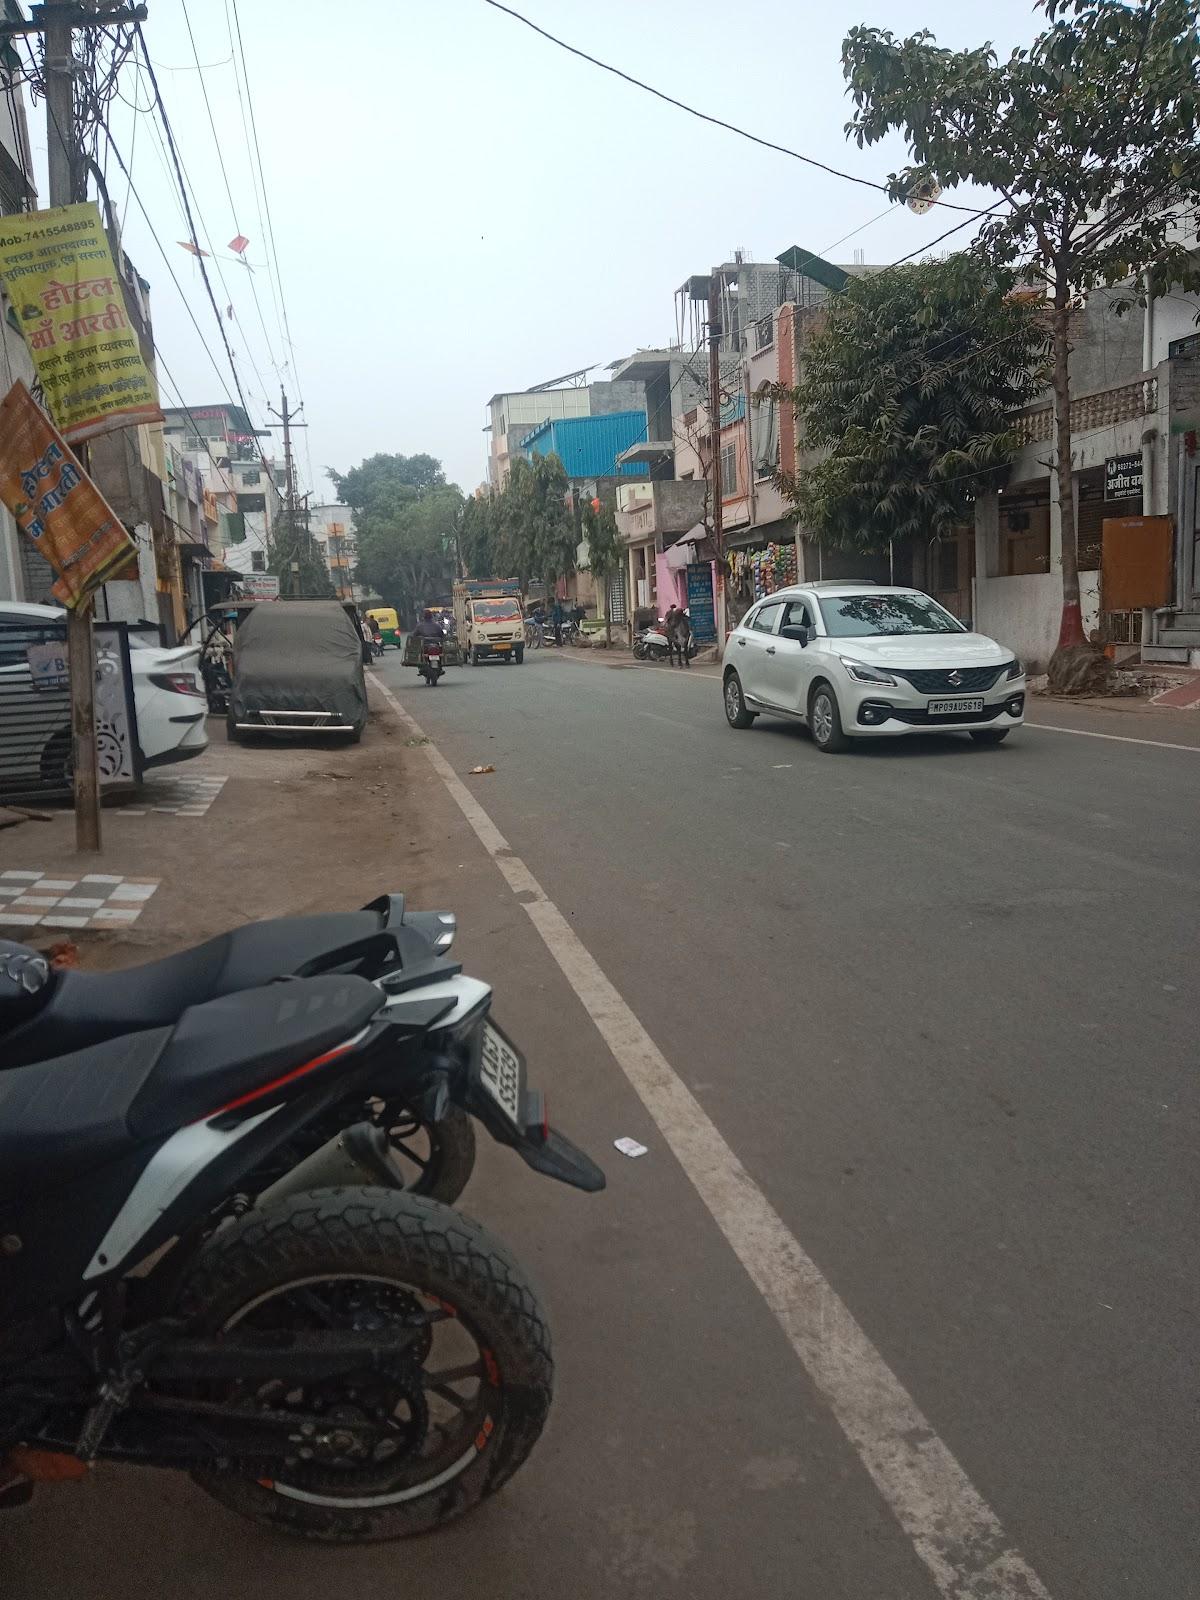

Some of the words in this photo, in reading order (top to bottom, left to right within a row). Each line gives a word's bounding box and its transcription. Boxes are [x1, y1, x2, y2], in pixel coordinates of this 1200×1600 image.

[40, 277, 114, 311] होटल
[28, 318, 56, 350] माँ
[59, 303, 126, 341] आरती
[21, 442, 62, 499] होटल
[1107, 473, 1130, 490] अजीत
